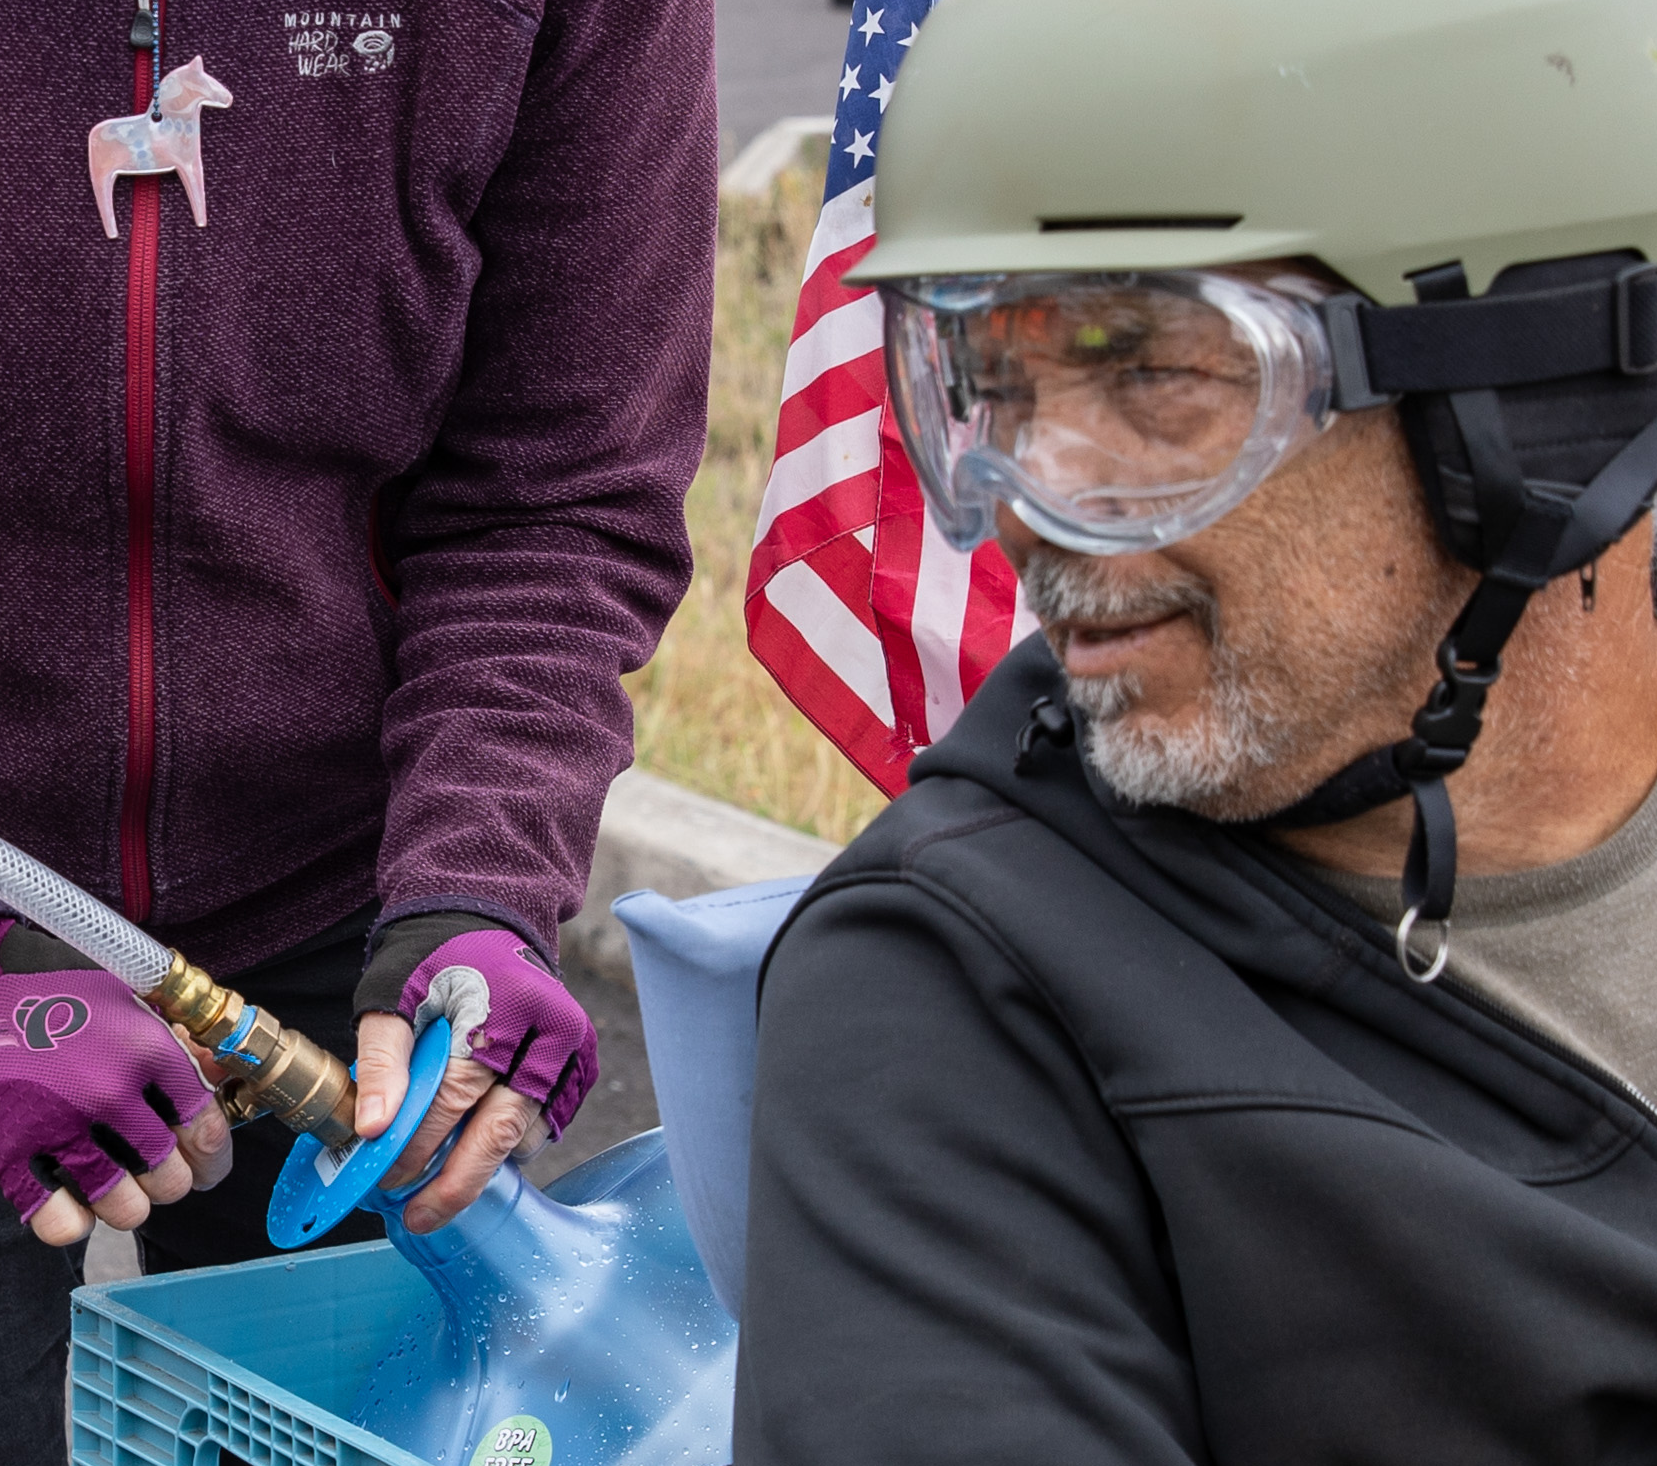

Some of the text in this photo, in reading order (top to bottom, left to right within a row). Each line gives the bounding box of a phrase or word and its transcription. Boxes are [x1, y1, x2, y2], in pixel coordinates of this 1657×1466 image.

[284, 11, 401, 28] MOUNTAIN
[288, 29, 339, 54] HARD
[298, 53, 352, 77] WEAR
[494, 1427, 537, 1452] BPA
